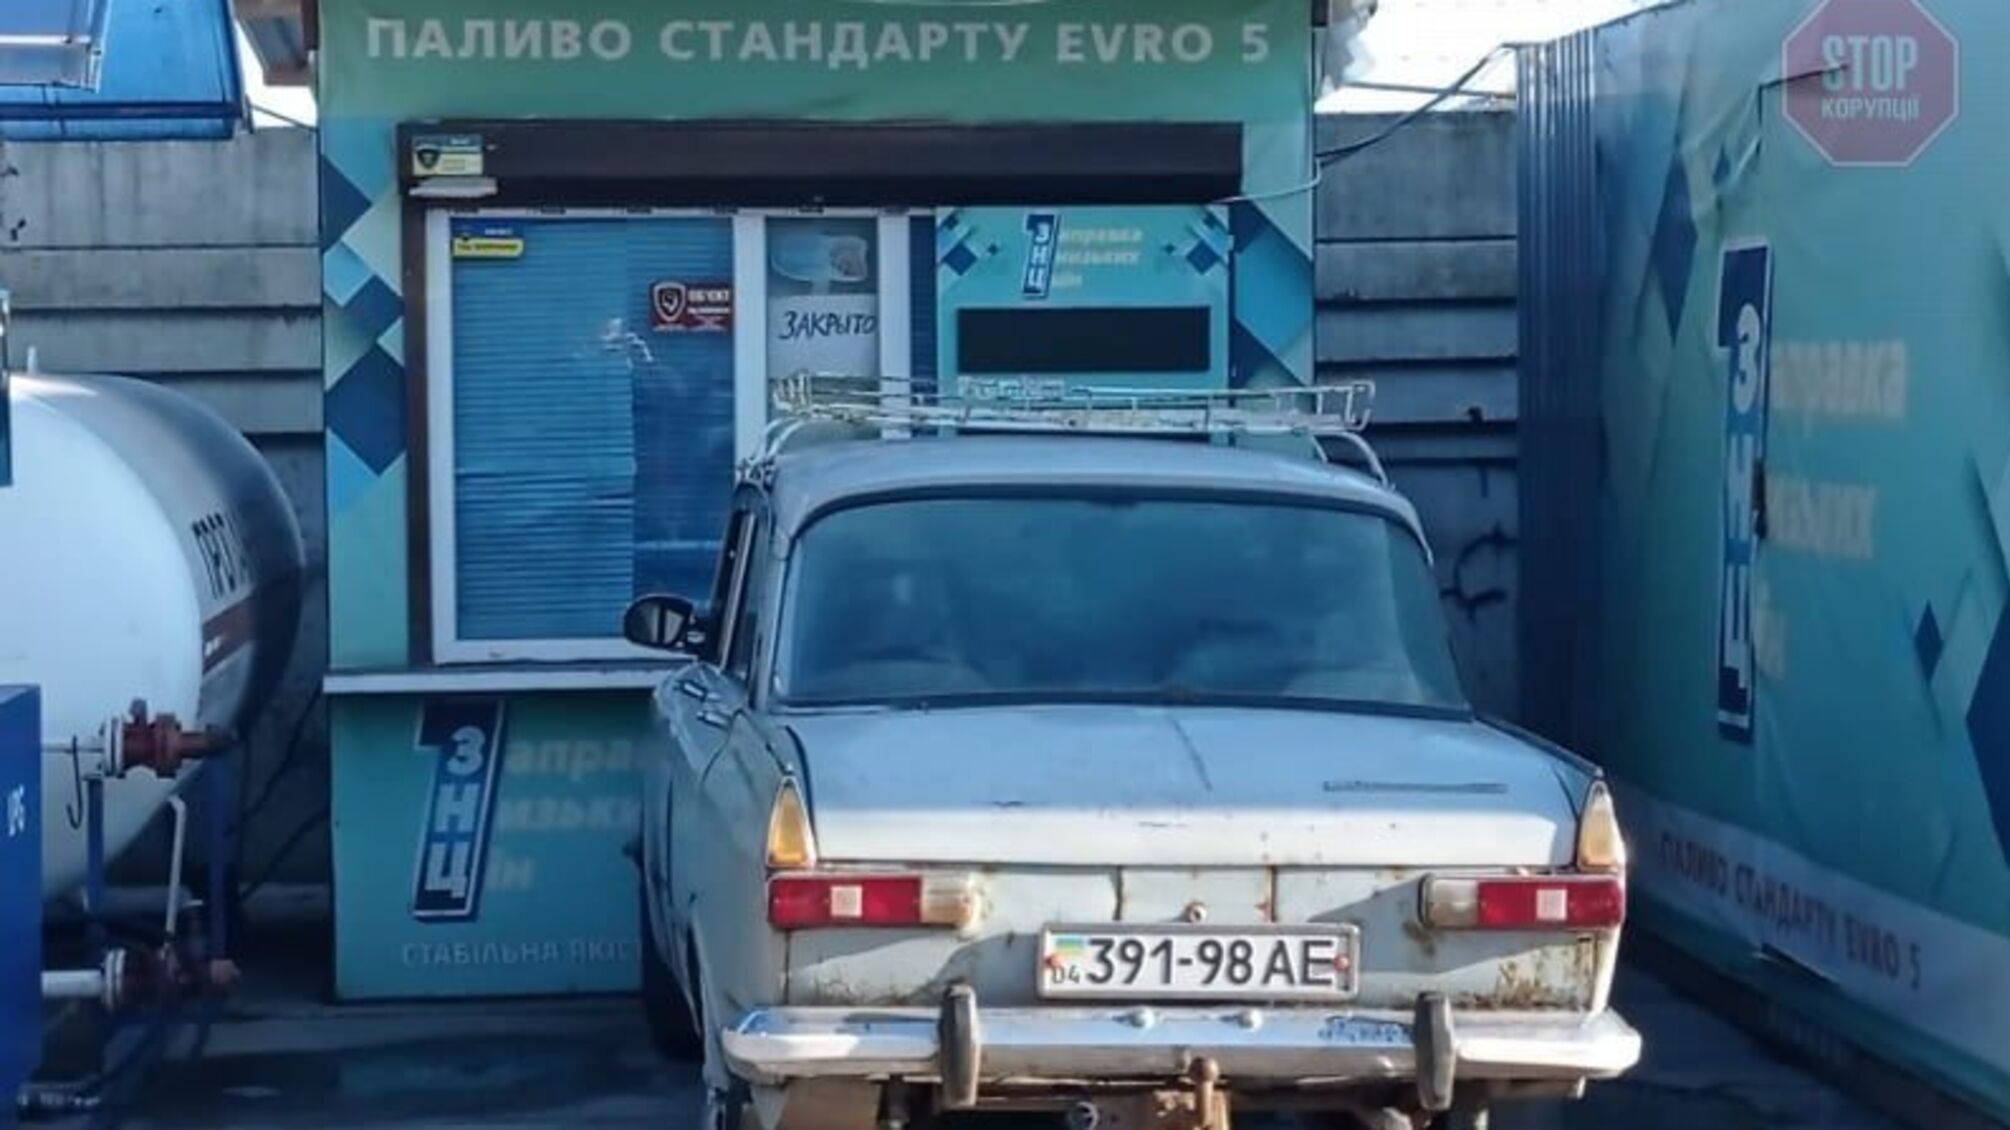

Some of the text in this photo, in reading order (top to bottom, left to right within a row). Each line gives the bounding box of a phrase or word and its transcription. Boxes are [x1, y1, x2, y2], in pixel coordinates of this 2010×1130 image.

[366, 17, 1271, 69] ПАЛИВО СТАНДАРТУ EVRO 5
[777, 309, 878, 340] ЗАКРЫТО
[568, 937, 640, 966] ЯКІС
